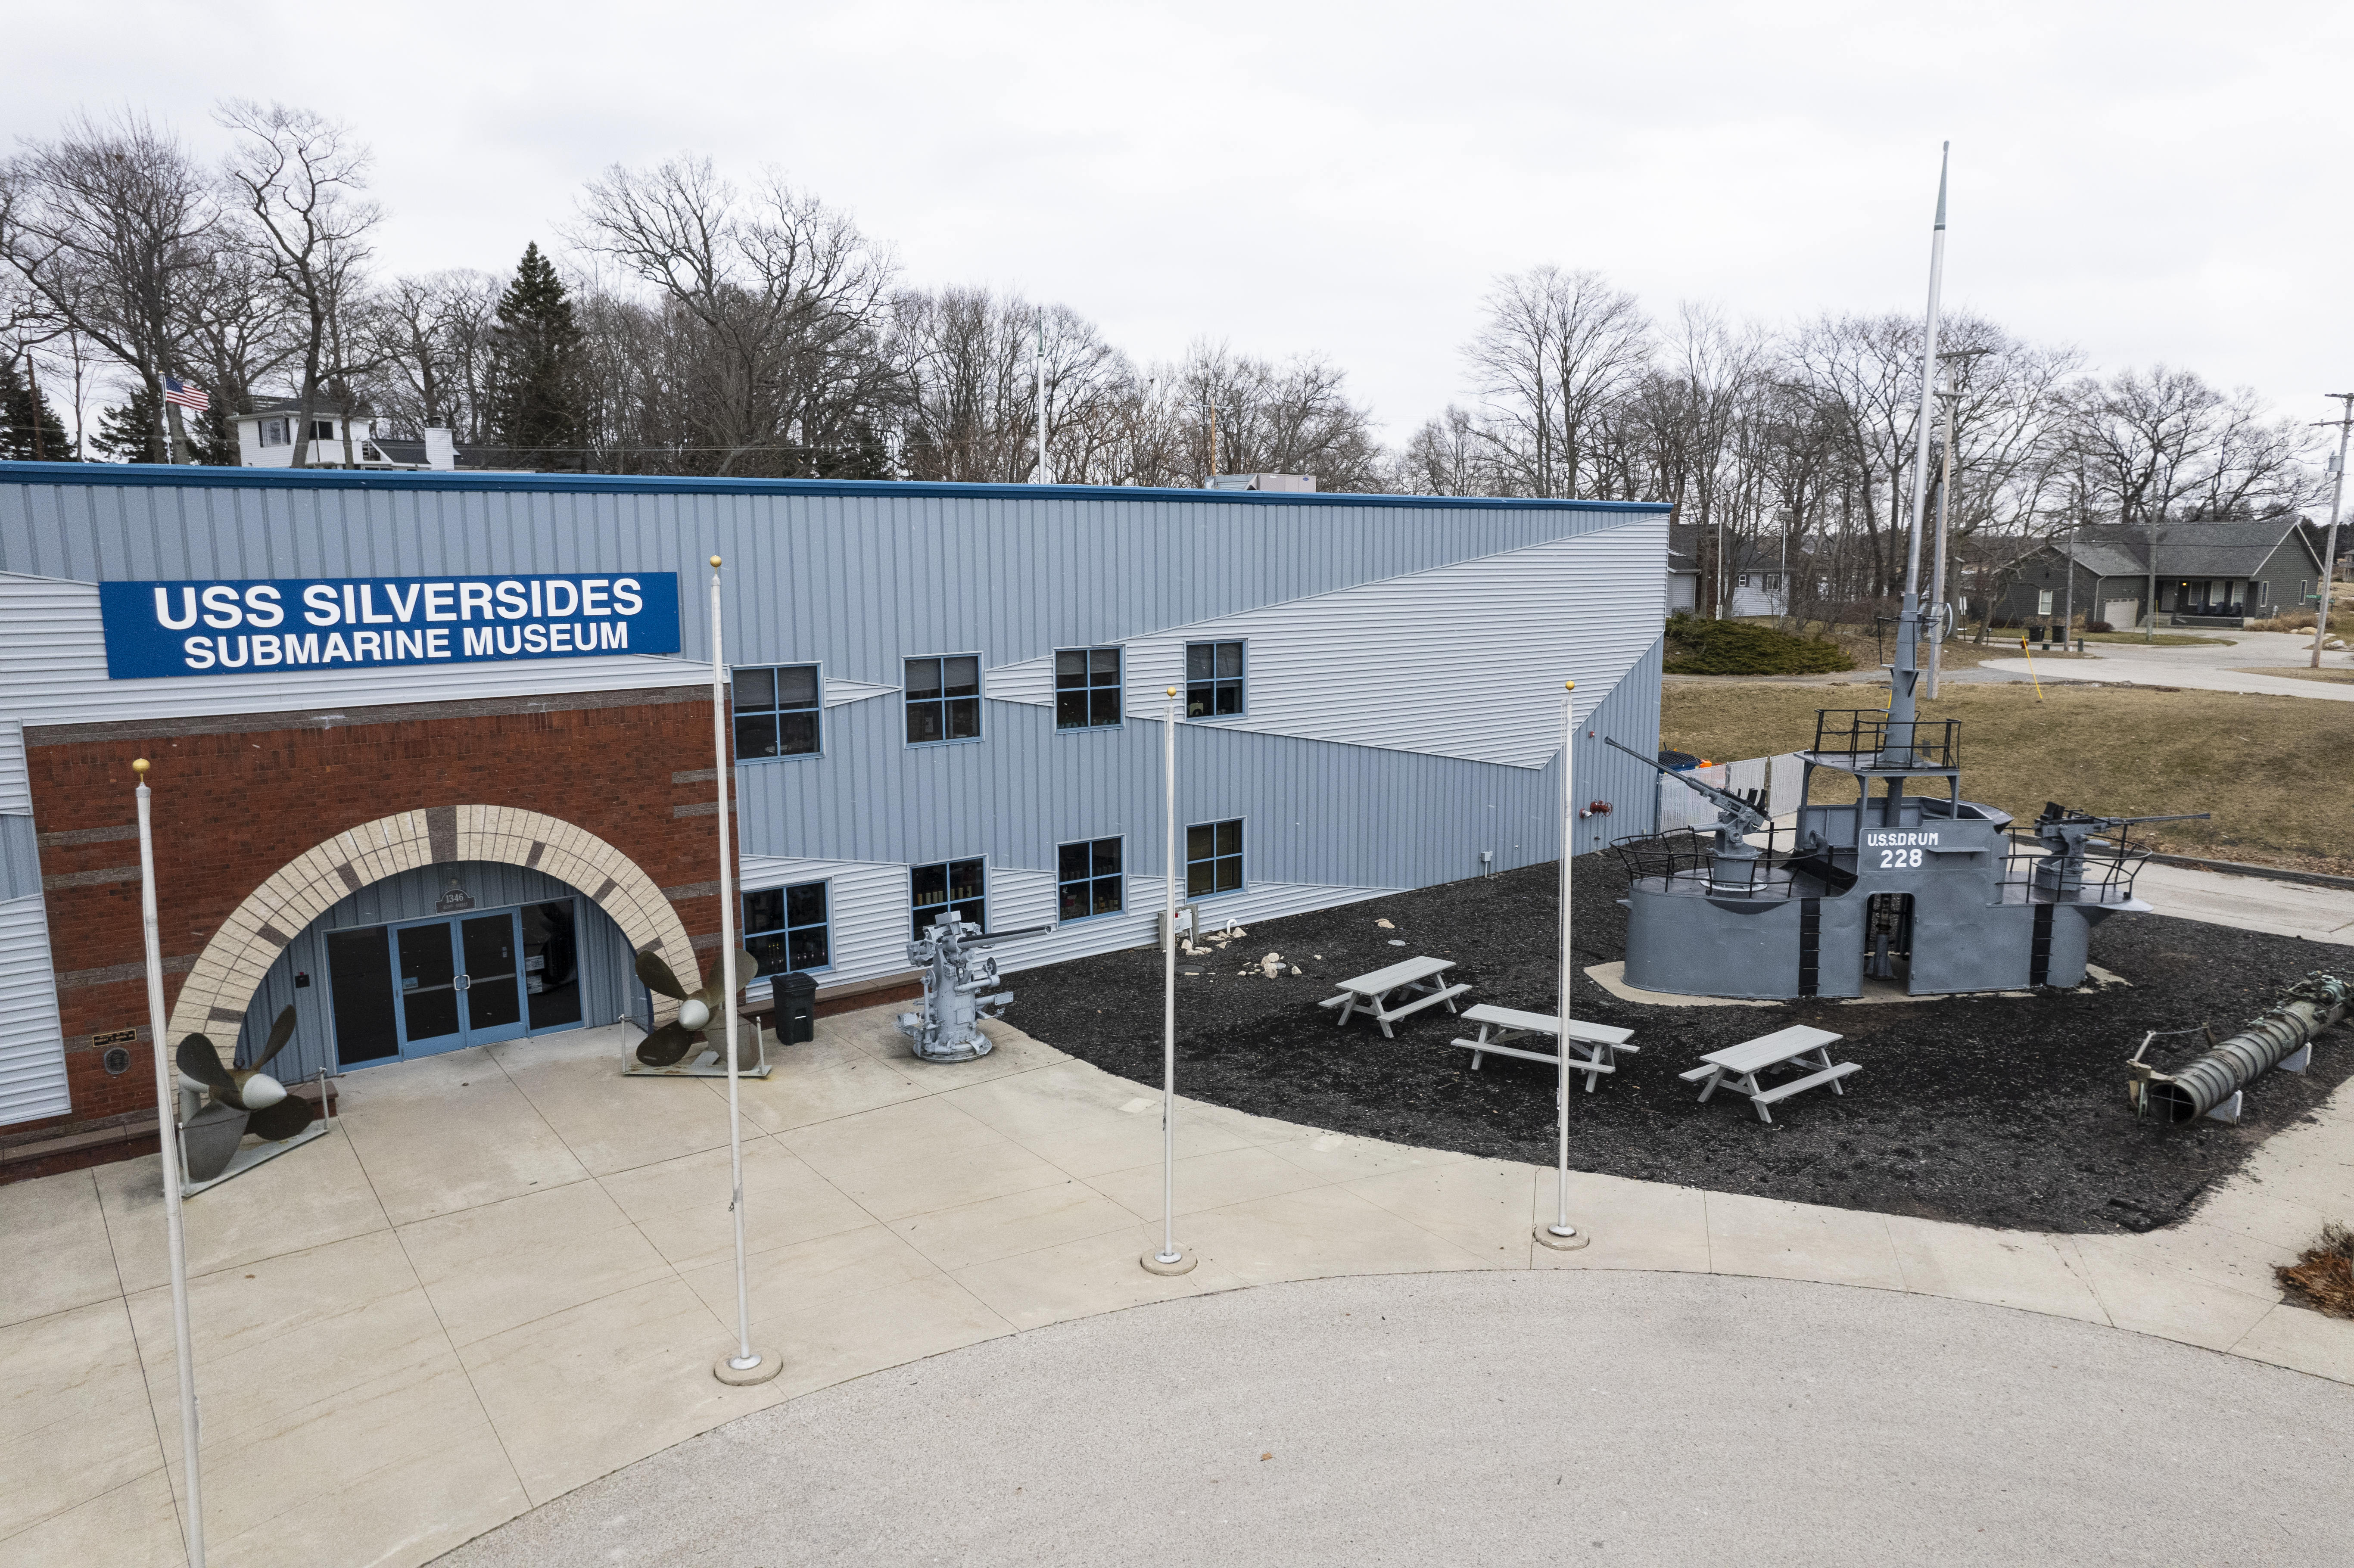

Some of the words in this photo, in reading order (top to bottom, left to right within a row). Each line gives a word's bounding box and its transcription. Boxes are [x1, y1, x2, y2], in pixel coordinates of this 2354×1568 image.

[155, 585, 284, 630] USS
[303, 578, 643, 626] SILVERSIDES
[184, 628, 451, 669] SUBMARINE
[463, 622, 628, 656] MUSEUM
[1880, 849, 1922, 868] 228
[445, 893, 464, 903] 1346
